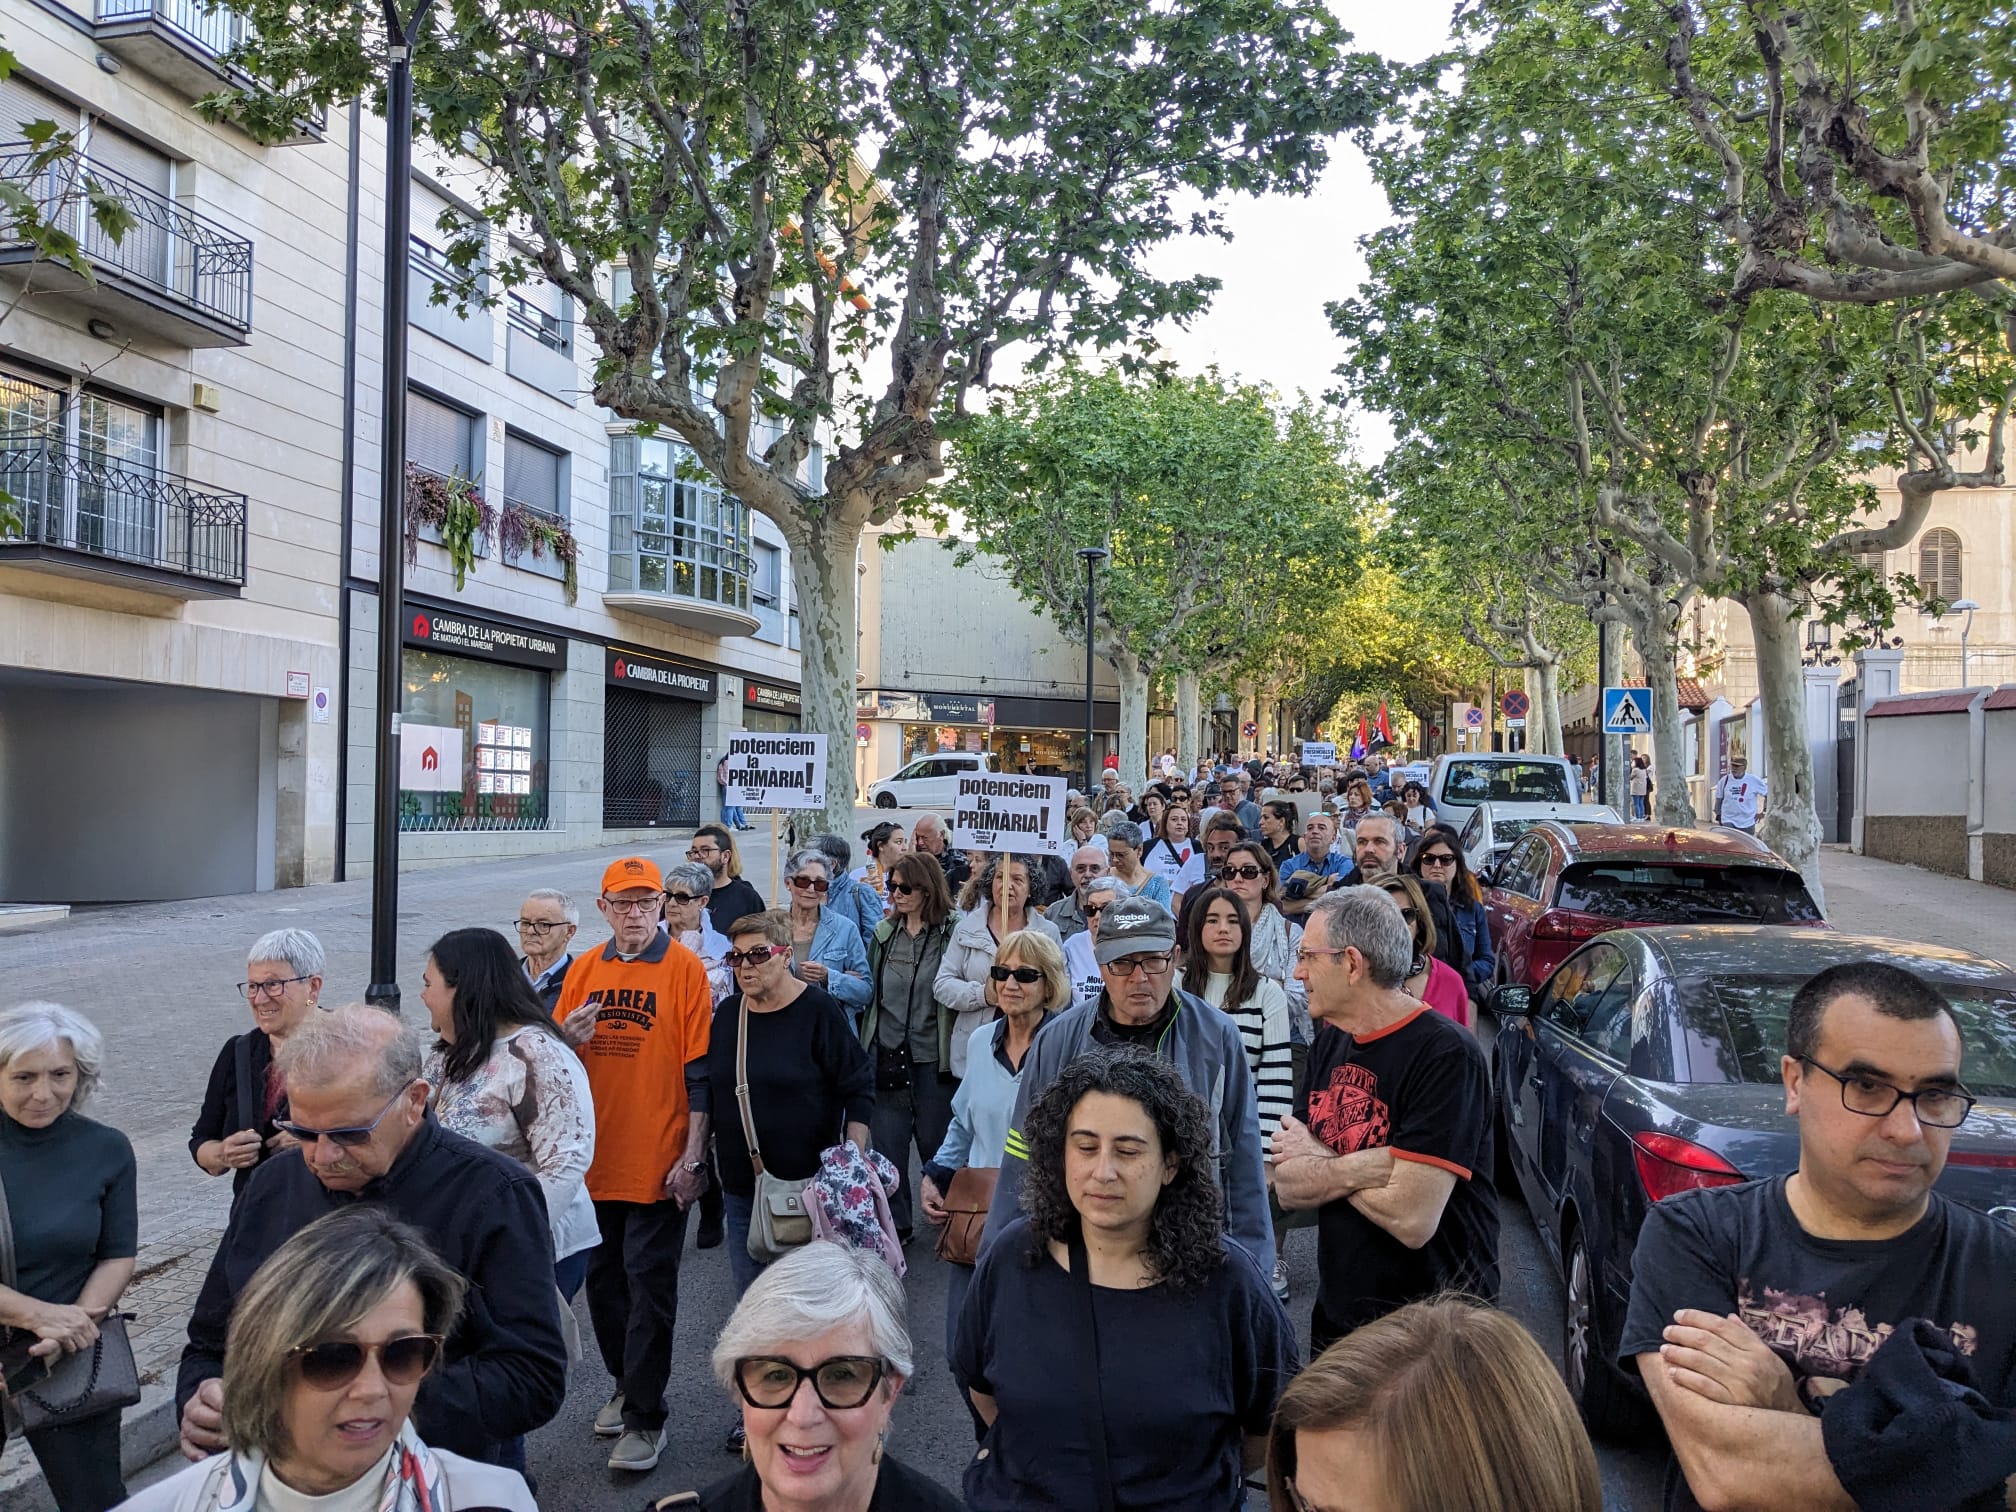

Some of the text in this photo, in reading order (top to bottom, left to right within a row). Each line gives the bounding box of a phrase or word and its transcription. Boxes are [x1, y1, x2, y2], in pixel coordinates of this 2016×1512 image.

[432, 618, 556, 654] CAMBRA DE LA PROPIETAT URBANA
[432, 632, 440, 641] DE
[464, 637, 470, 647] EL
[471, 639, 494, 651] MARESME
[627, 663, 710, 692] CAMBRA DE LA PROPIETAT
[933, 704, 976, 712] MONUMENTAL
[730, 737, 815, 756] potenciem
[747, 754, 759, 769] la
[728, 763, 814, 794] PRIMÀRIA!
[959, 778, 1051, 800] potenciem
[977, 796, 990, 811] la
[957, 807, 1050, 839] PRIMÀRIA!
[1113, 913, 1150, 922] Reebok
